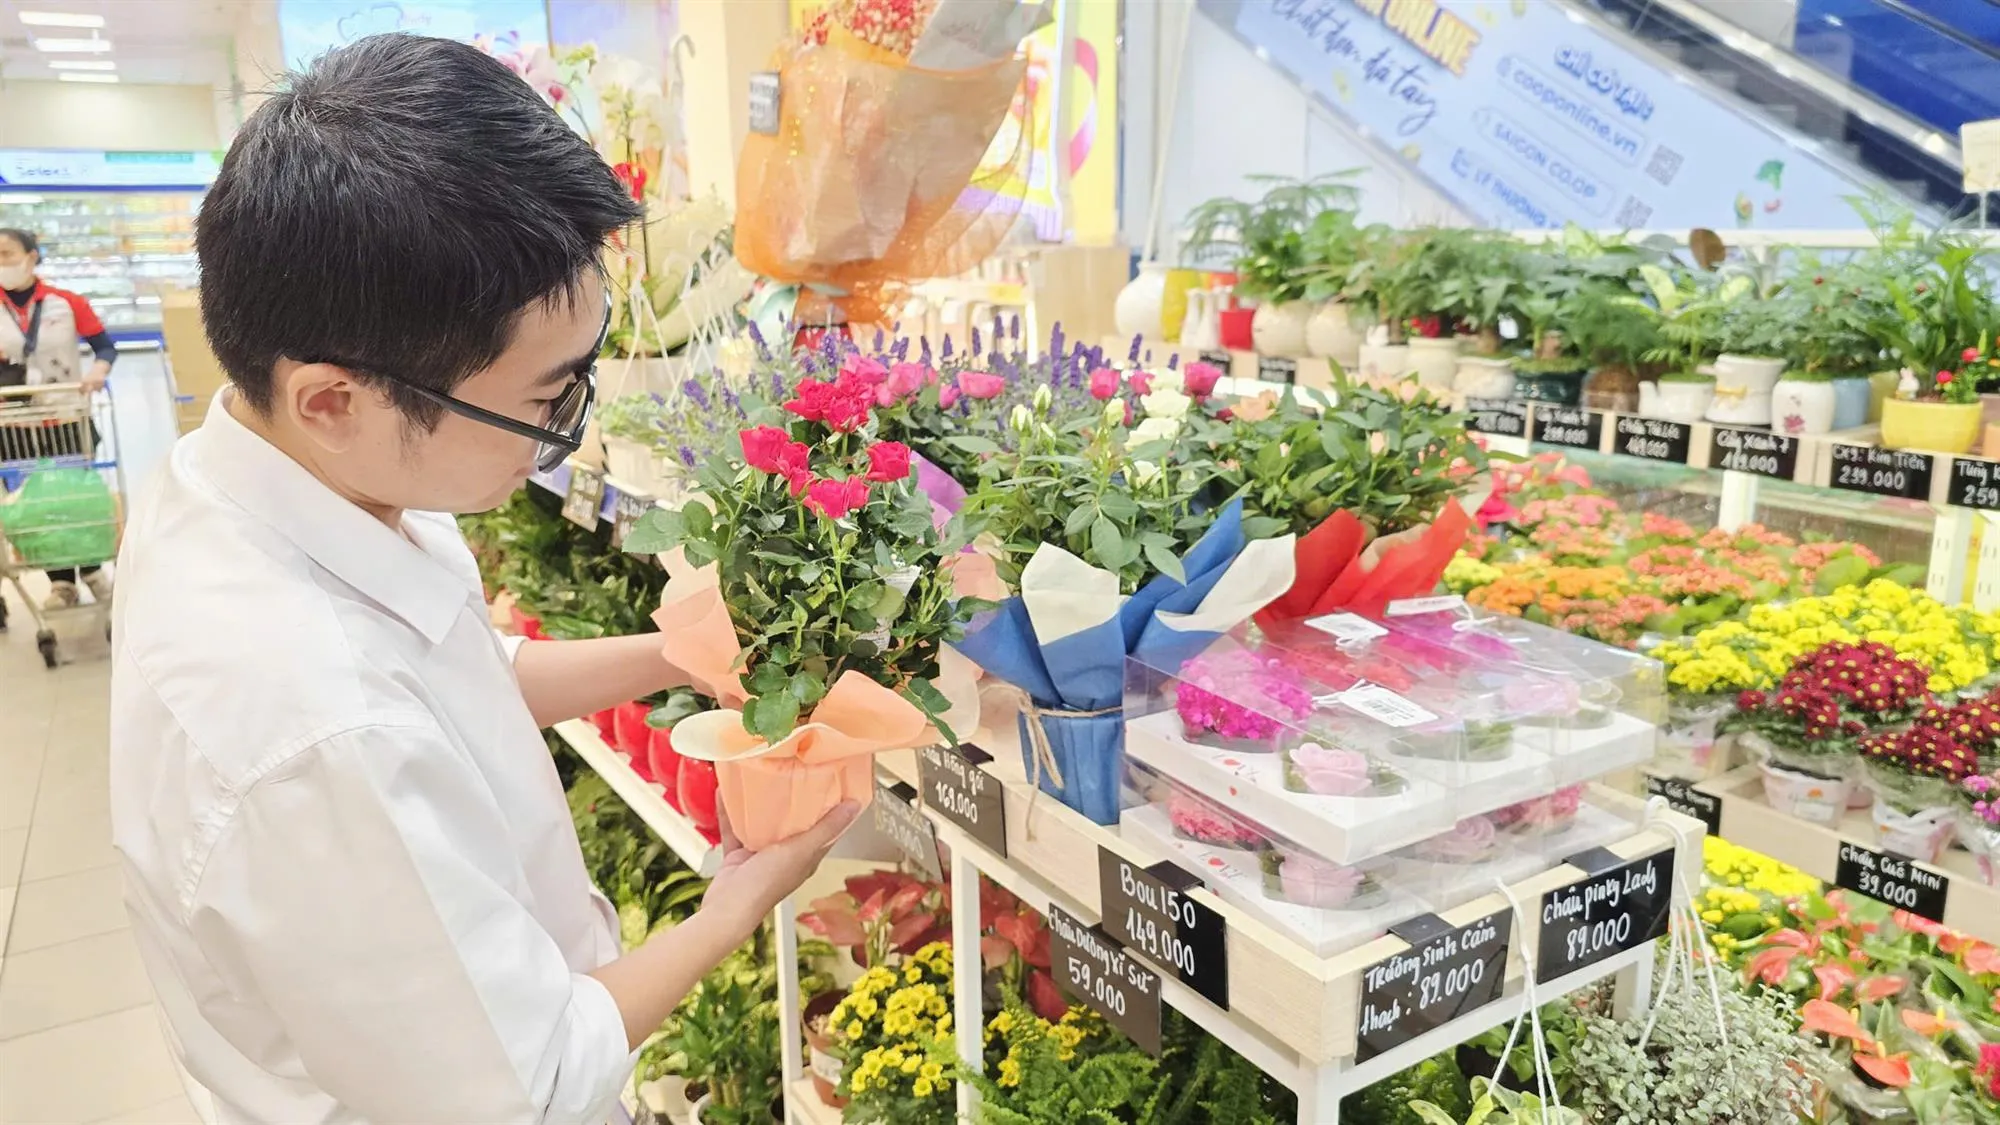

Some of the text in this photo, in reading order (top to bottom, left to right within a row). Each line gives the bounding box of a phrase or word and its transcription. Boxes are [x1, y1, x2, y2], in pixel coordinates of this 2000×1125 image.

[1512, 68, 1639, 158] cooponline.vn
[1494, 122, 1548, 167] SAIGON
[1838, 464, 1906, 491] 239.000
[935, 780, 978, 825] 169.000
[1622, 859, 1656, 895] Lady
[1857, 870, 1918, 908] 39.000
[1160, 886, 1196, 929] 150
[1125, 906, 1195, 977] 149.000
[1566, 911, 1631, 963] 89.000
[1067, 956, 1126, 1017] 59.000
[1419, 958, 1485, 1010] 89.000
